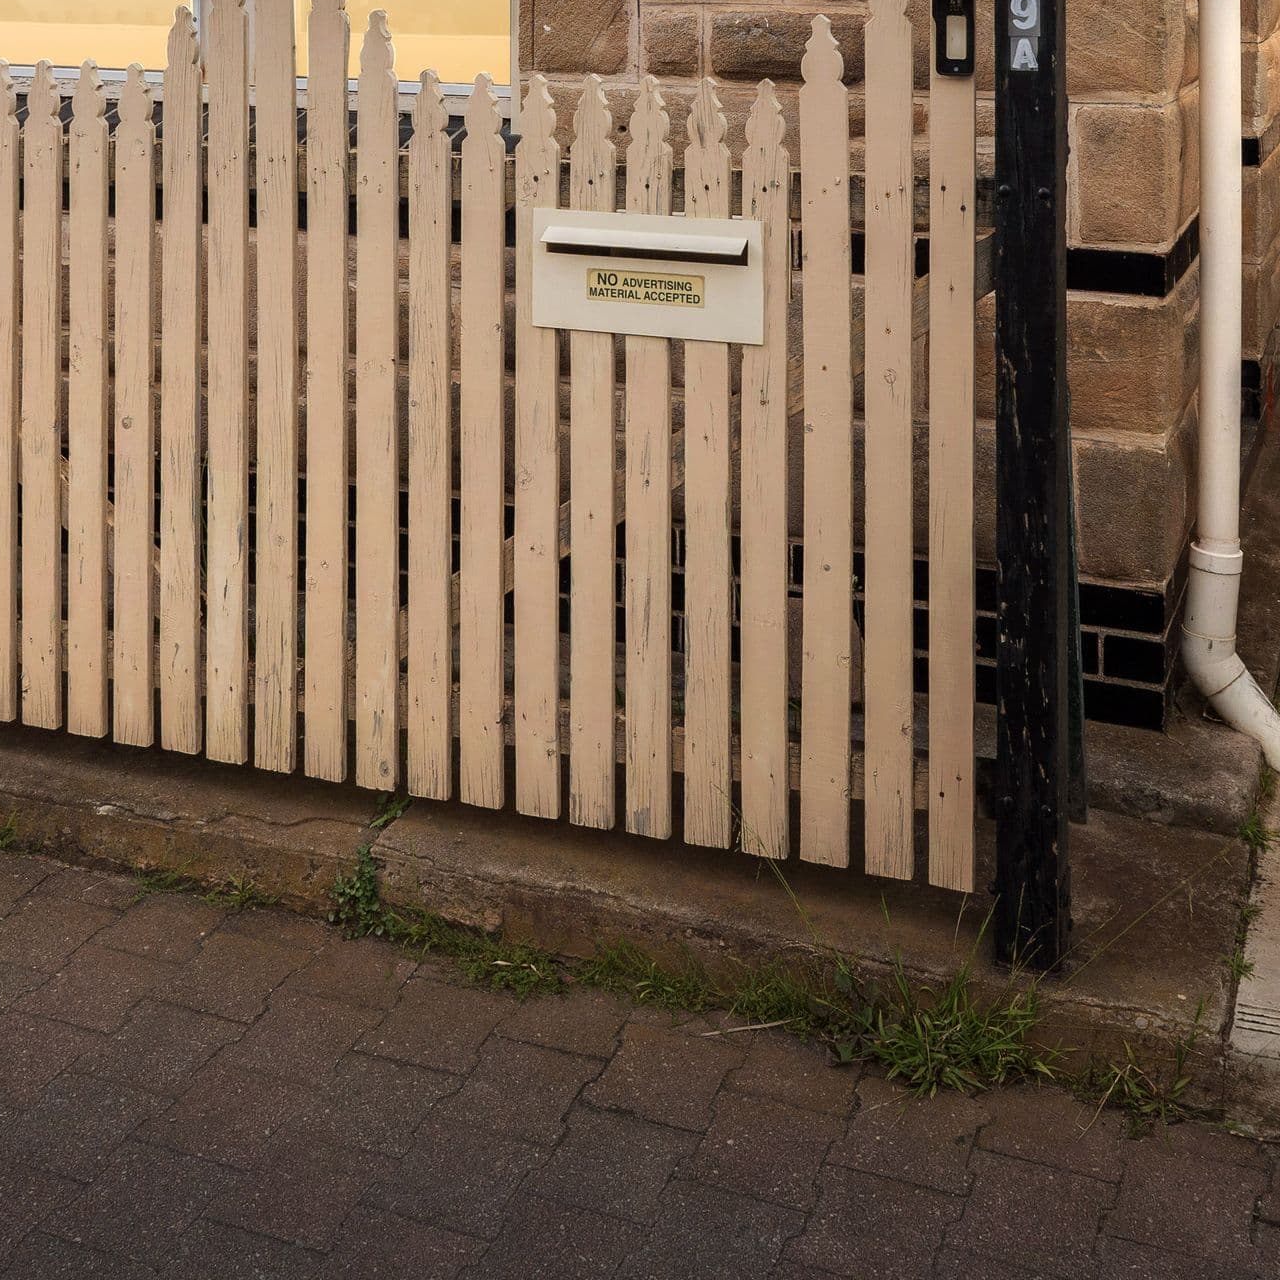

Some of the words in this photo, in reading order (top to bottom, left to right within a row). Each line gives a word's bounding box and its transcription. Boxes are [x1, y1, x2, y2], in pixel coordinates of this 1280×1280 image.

[597, 272, 618, 286] NO
[622, 277, 692, 292] ADVERTISING
[589, 287, 641, 301] MATERIAL
[643, 291, 701, 305] ACCEPTED
